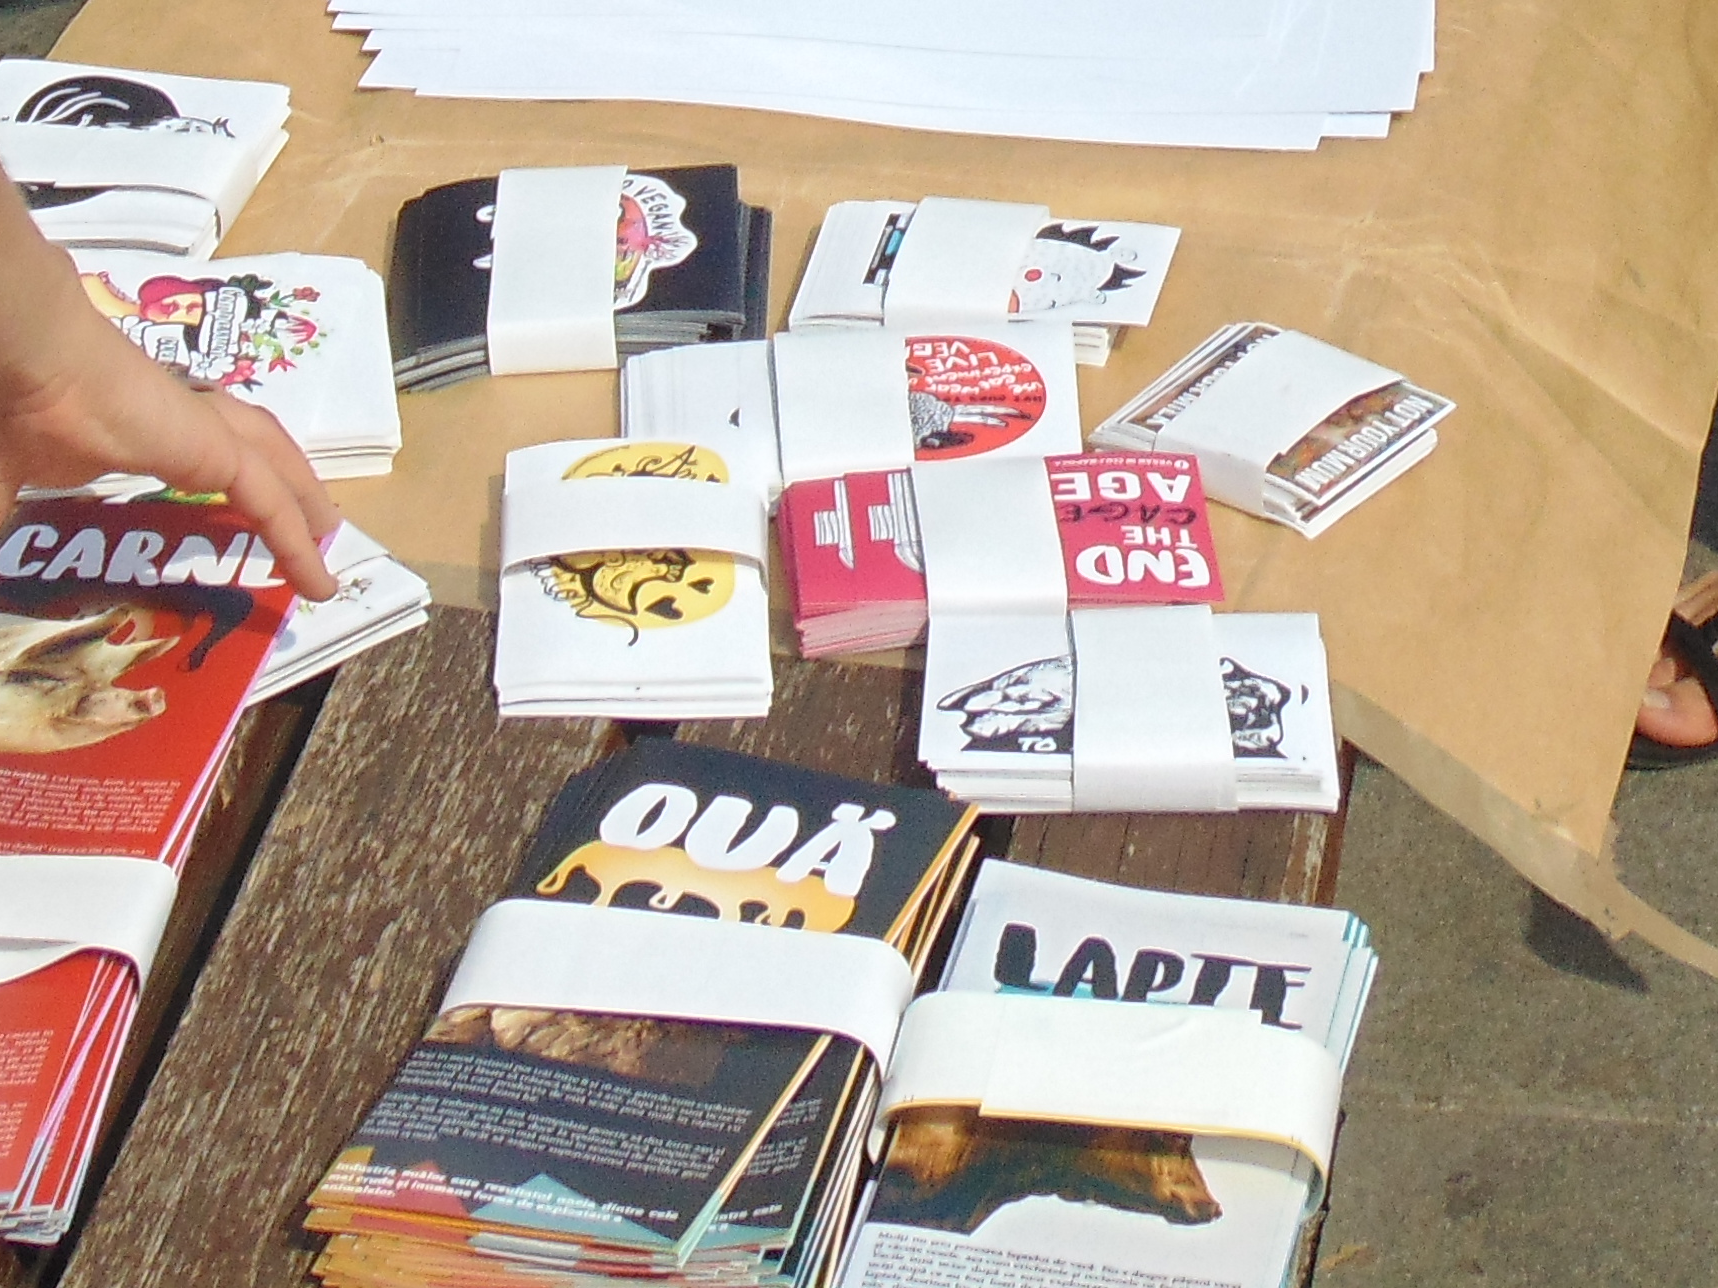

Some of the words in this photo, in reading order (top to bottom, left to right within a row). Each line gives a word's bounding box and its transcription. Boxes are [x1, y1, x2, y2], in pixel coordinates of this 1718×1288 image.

[633, 184, 673, 236] VEGAN
[906, 340, 970, 358] VEG
[925, 351, 999, 372] LIVE
[1384, 394, 1433, 427] NOT
[1336, 420, 1400, 458] YOUR
[1050, 472, 1192, 503] AGE
[1294, 449, 1355, 491] MUM
[1059, 502, 1197, 525] CAGE
[1121, 525, 1197, 548] THE
[1075, 545, 1210, 588] END
[600, 782, 897, 897] OUĂ
[994, 921, 1312, 1031] LAPTE
